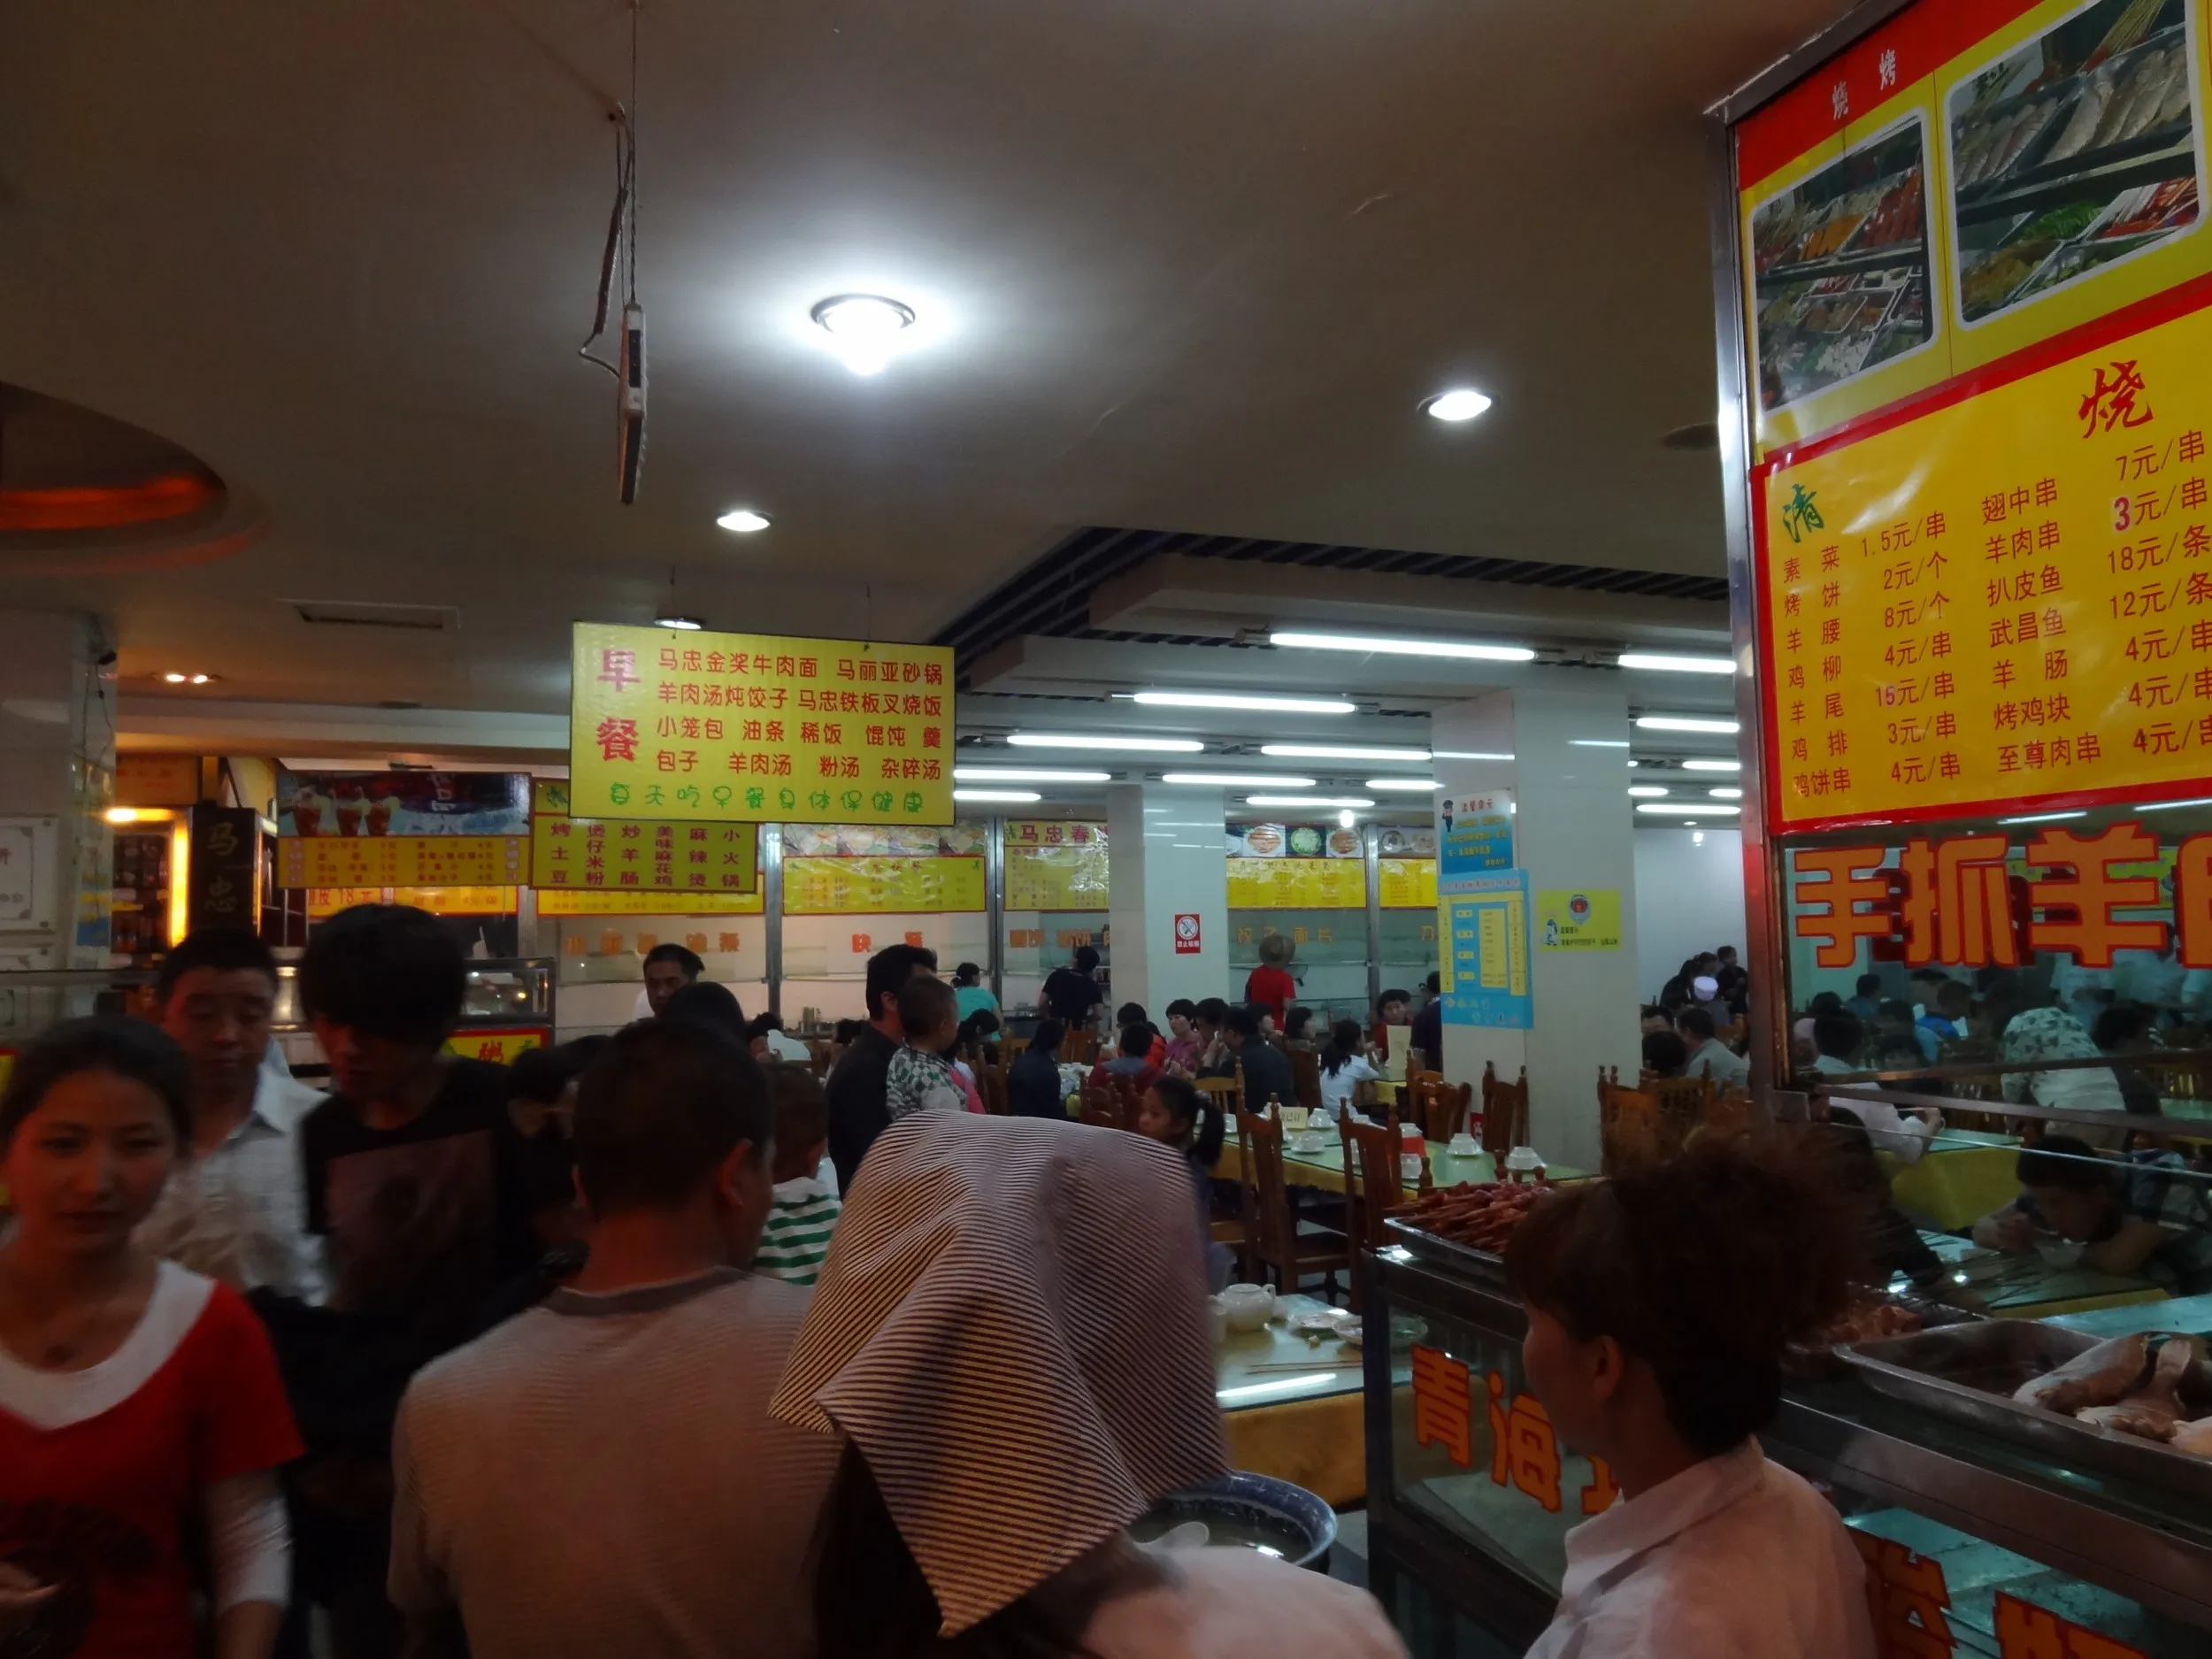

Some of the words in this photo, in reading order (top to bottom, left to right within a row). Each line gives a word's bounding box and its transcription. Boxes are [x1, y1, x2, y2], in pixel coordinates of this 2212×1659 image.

[2078, 358, 2154, 440] 烧
[1782, 483, 1824, 543] 清
[1981, 477, 2058, 526] 翅中串
[2116, 429, 2205, 481] 7元/串
[1883, 550, 1948, 590] 2元/个
[1985, 519, 2061, 564] 羊肉串
[2113, 477, 2208, 532] 3元/串
[1885, 590, 1950, 629] 8元/个
[1987, 563, 2064, 608] 扒皮鱼
[2108, 524, 2212, 574] 18元/条
[1884, 630, 1952, 668] 4元/串
[1989, 607, 2067, 649] 武昌鱼
[2109, 572, 2212, 619] 12元/条
[657, 680, 787, 709] 羊肉汤炖饺子
[797, 689, 942, 718] 马忠铁板叉烧饭
[658, 648, 818, 679] 马忠金奖牛肉面
[836, 658, 942, 686] 马丽亚砂锅
[1875, 671, 1955, 707] 15元/串
[2125, 618, 2212, 663] 4元/串
[596, 649, 641, 762] 早餐
[657, 715, 724, 741] 小笼包
[742, 719, 785, 742] 油条
[800, 721, 842, 745] 稀饭
[865, 724, 906, 748] 馄饨
[1887, 710, 1957, 746] 3元/串
[1993, 692, 2071, 731] 烤鸡块
[657, 749, 699, 772] 包子
[728, 751, 792, 776] 羊肉汤
[819, 754, 860, 778] 粉汤
[881, 757, 941, 780] 杂碎汤
[1793, 766, 1851, 798] 鸡饼串
[1891, 751, 1961, 785] 4元/串
[1997, 732, 2101, 772] 至尊肉串
[722, 829, 741, 887] 小火锅
[1794, 819, 2212, 969] 手抓羊
